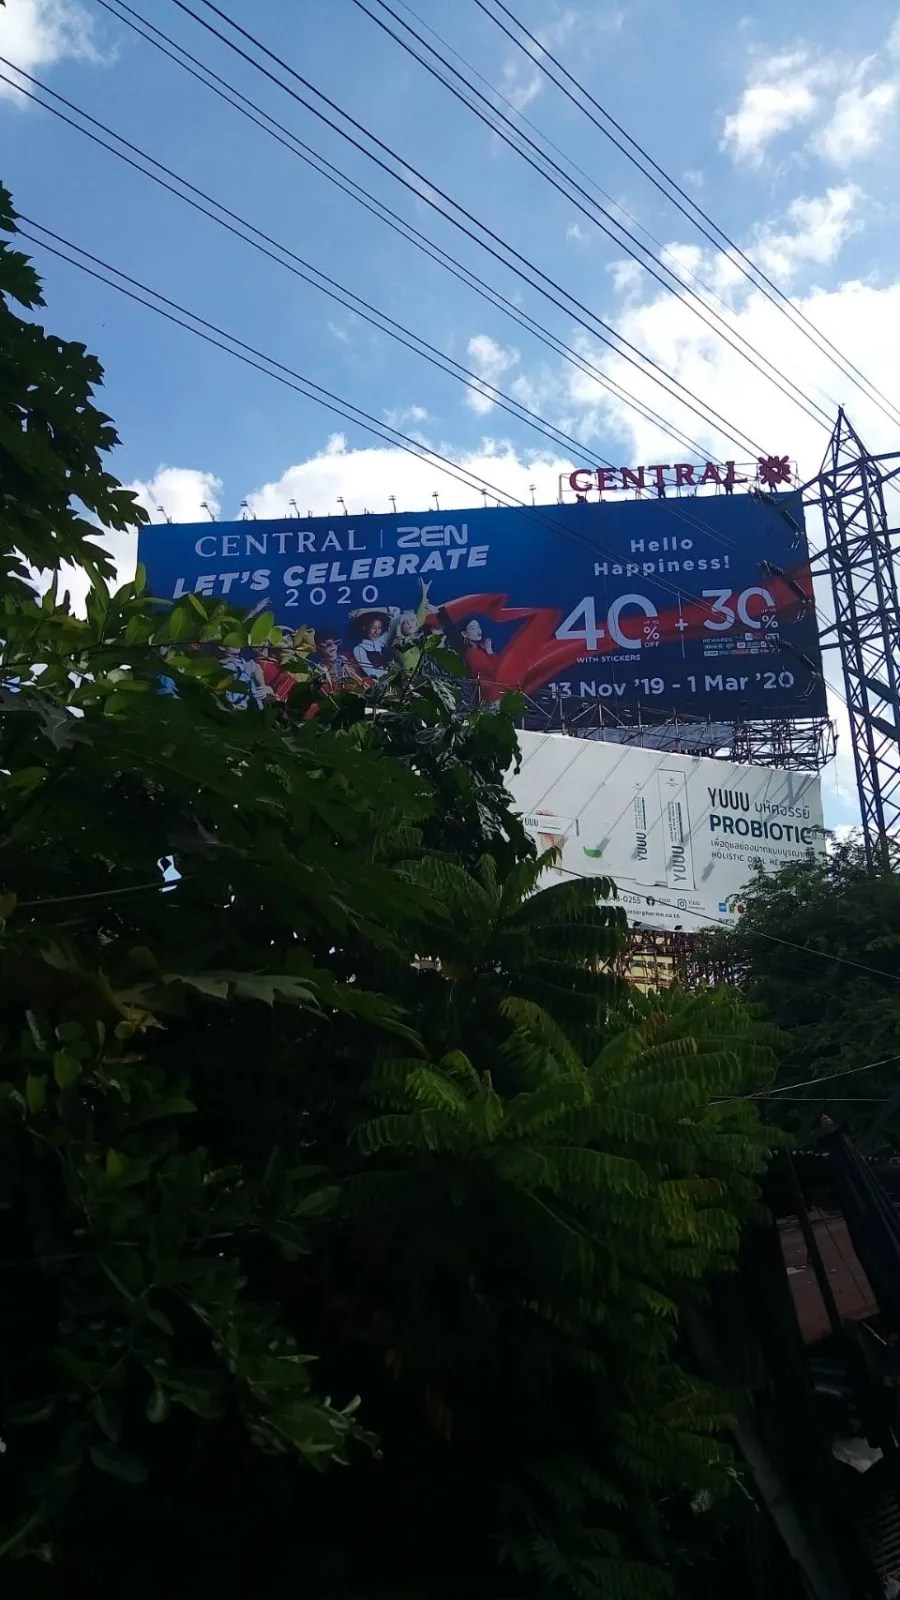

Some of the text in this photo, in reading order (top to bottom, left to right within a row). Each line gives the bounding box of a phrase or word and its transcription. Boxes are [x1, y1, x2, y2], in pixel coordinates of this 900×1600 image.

[569, 461, 747, 492] CENTRAL
[195, 524, 468, 557] CENTRAL ZEN
[630, 537, 693, 553] Hello
[172, 545, 489, 599] LET'S CELEBRATE
[594, 555, 730, 577] Happiness!
[284, 584, 379, 608] 2020
[576, 654, 641, 664] WITH STICKERS
[548, 682, 572, 699] 13
[580, 680, 626, 698] Nov
[634, 677, 665, 695] '19
[687, 675, 696, 692] 1
[705, 673, 748, 692] Mar
[755, 671, 794, 689] '20
[707, 787, 750, 812] YUUU
[523, 817, 540, 828] UUU
[709, 814, 813, 845] PROBIOTIC
[635, 832, 648, 862] YUUU
[711, 851, 745, 862] HOLISTIC
[671, 845, 687, 883] YUUU
